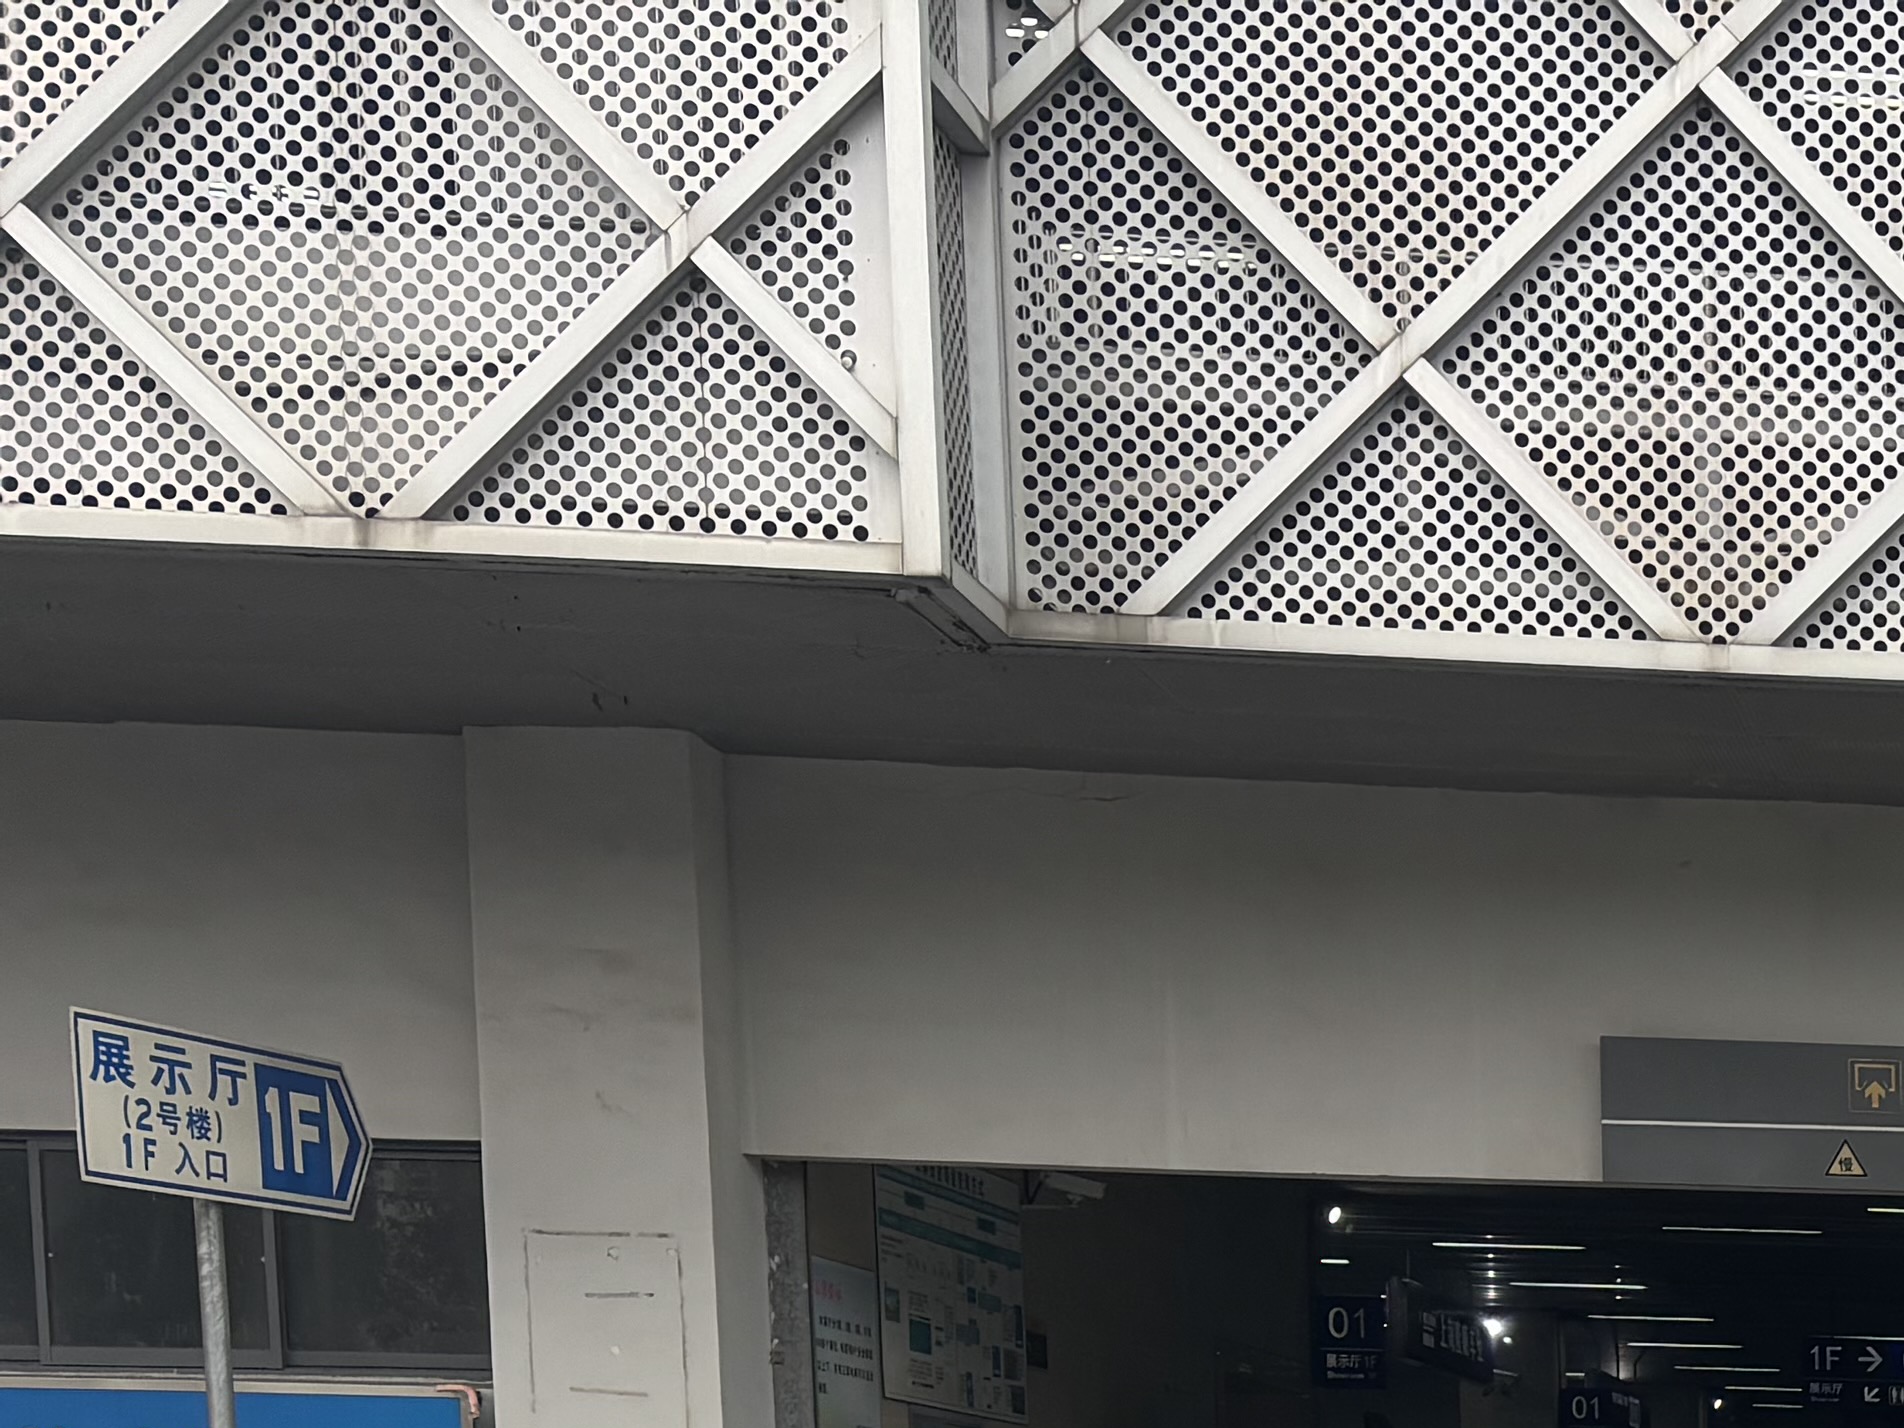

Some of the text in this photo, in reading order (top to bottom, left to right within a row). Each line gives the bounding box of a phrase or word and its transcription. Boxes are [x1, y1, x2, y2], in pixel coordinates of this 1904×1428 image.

[89, 1030, 247, 1107] 展示厅
[123, 1095, 223, 1144] (2号楼)
[265, 1086, 322, 1175] 1F
[122, 1133, 229, 1183] 1F 入口
[1838, 1157, 1854, 1172] 慢
[1327, 1306, 1367, 1340] 01
[1809, 1345, 1843, 1371] 1F
[1572, 1395, 1599, 1420] 01
